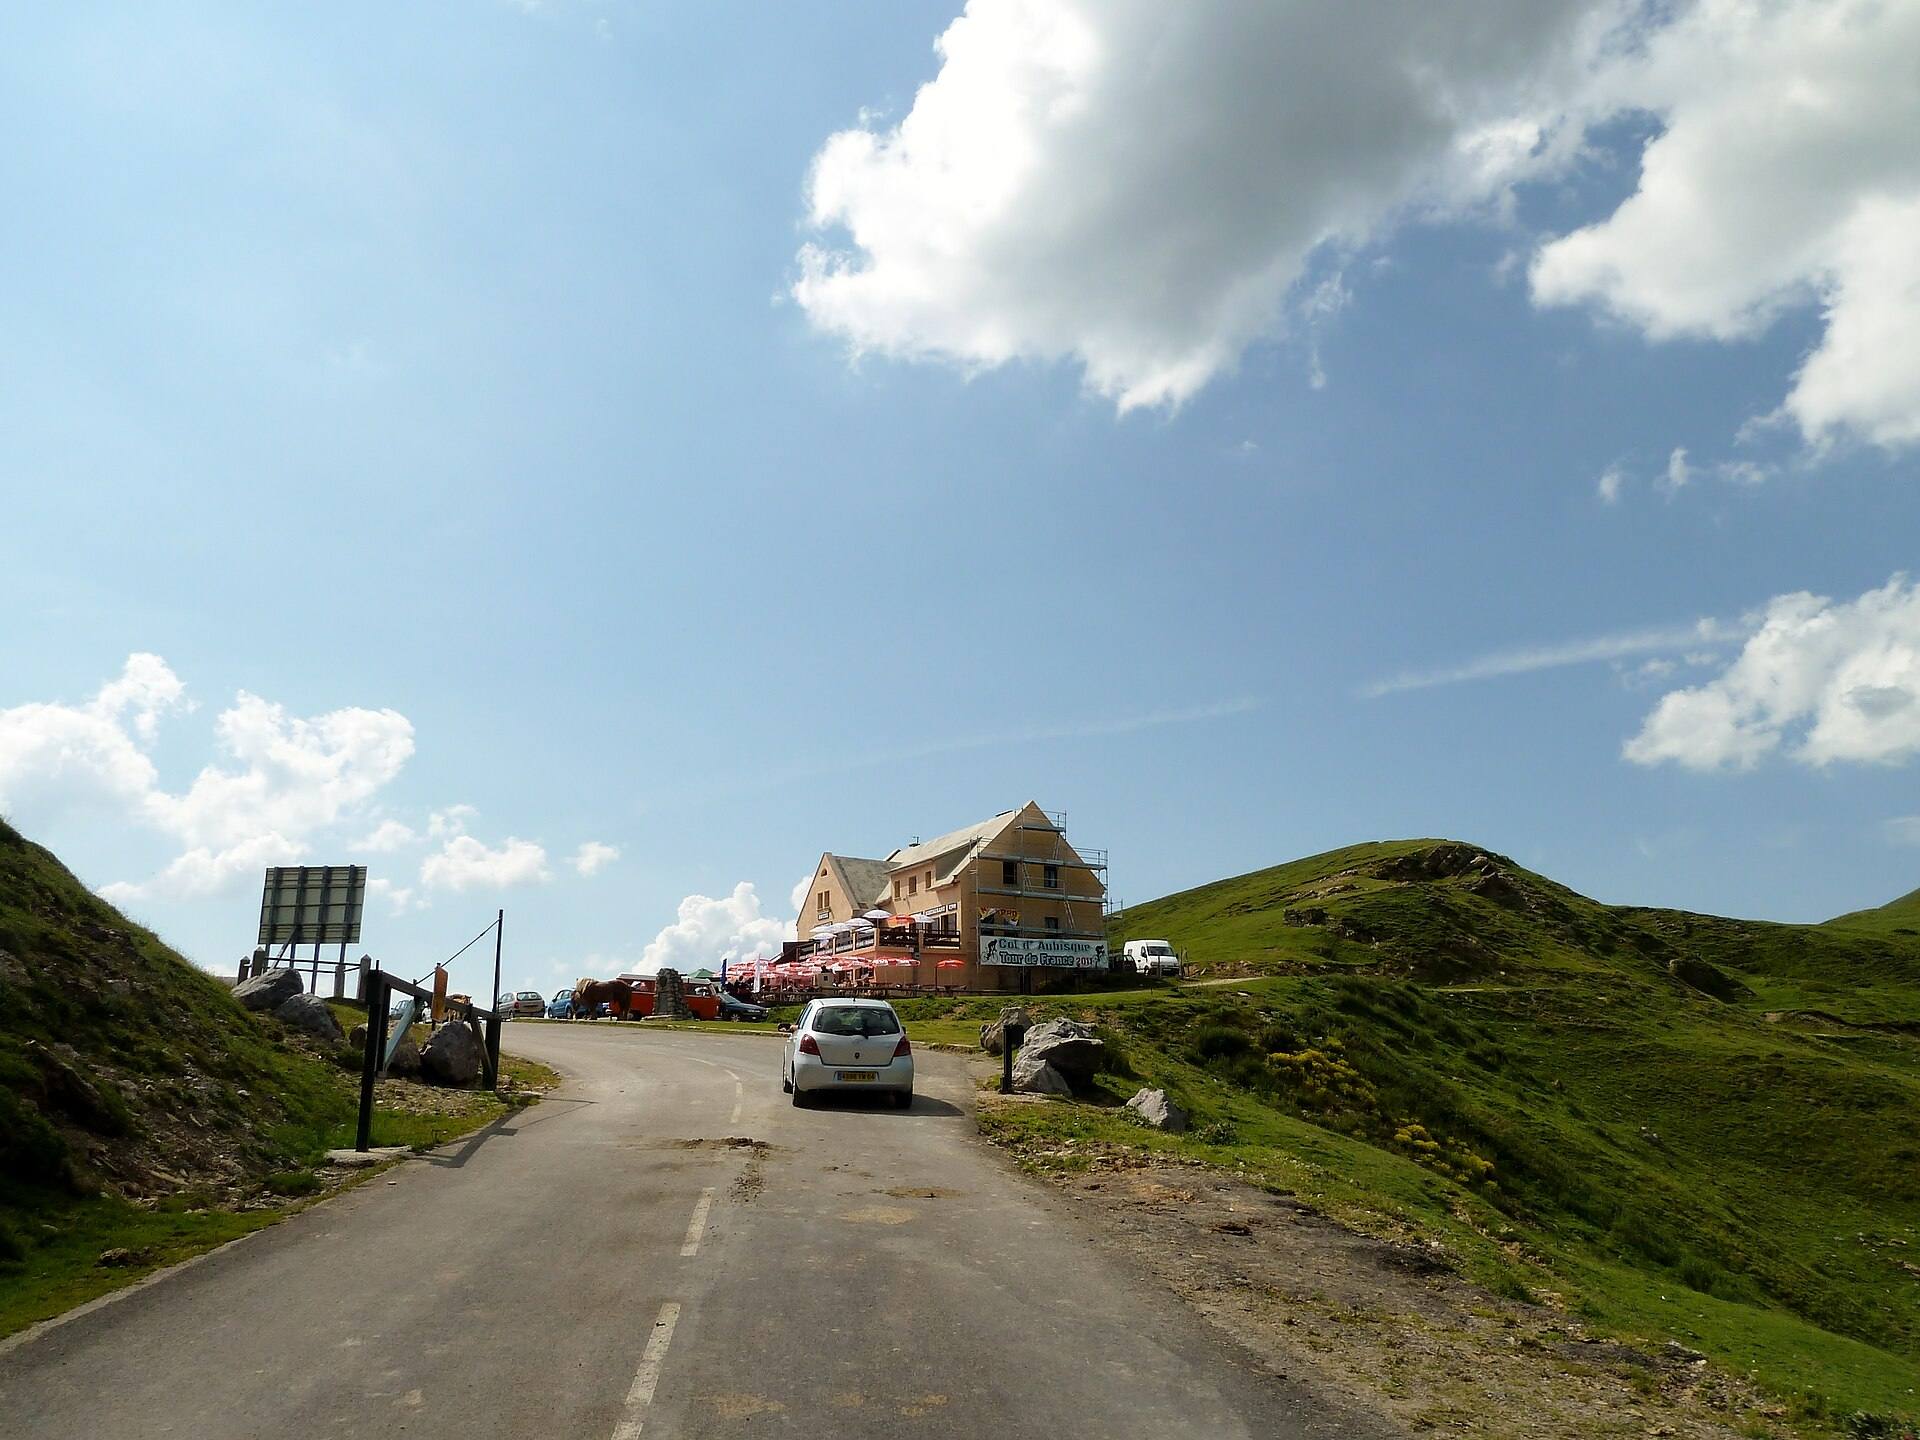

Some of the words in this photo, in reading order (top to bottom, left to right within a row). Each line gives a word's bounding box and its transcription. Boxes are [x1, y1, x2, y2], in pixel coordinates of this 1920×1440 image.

[999, 939, 1017, 949] Col
[1038, 941, 1091, 952] Aubisque
[999, 951, 1023, 964] Tour
[1025, 953, 1038, 965] de
[1040, 953, 1074, 966] France
